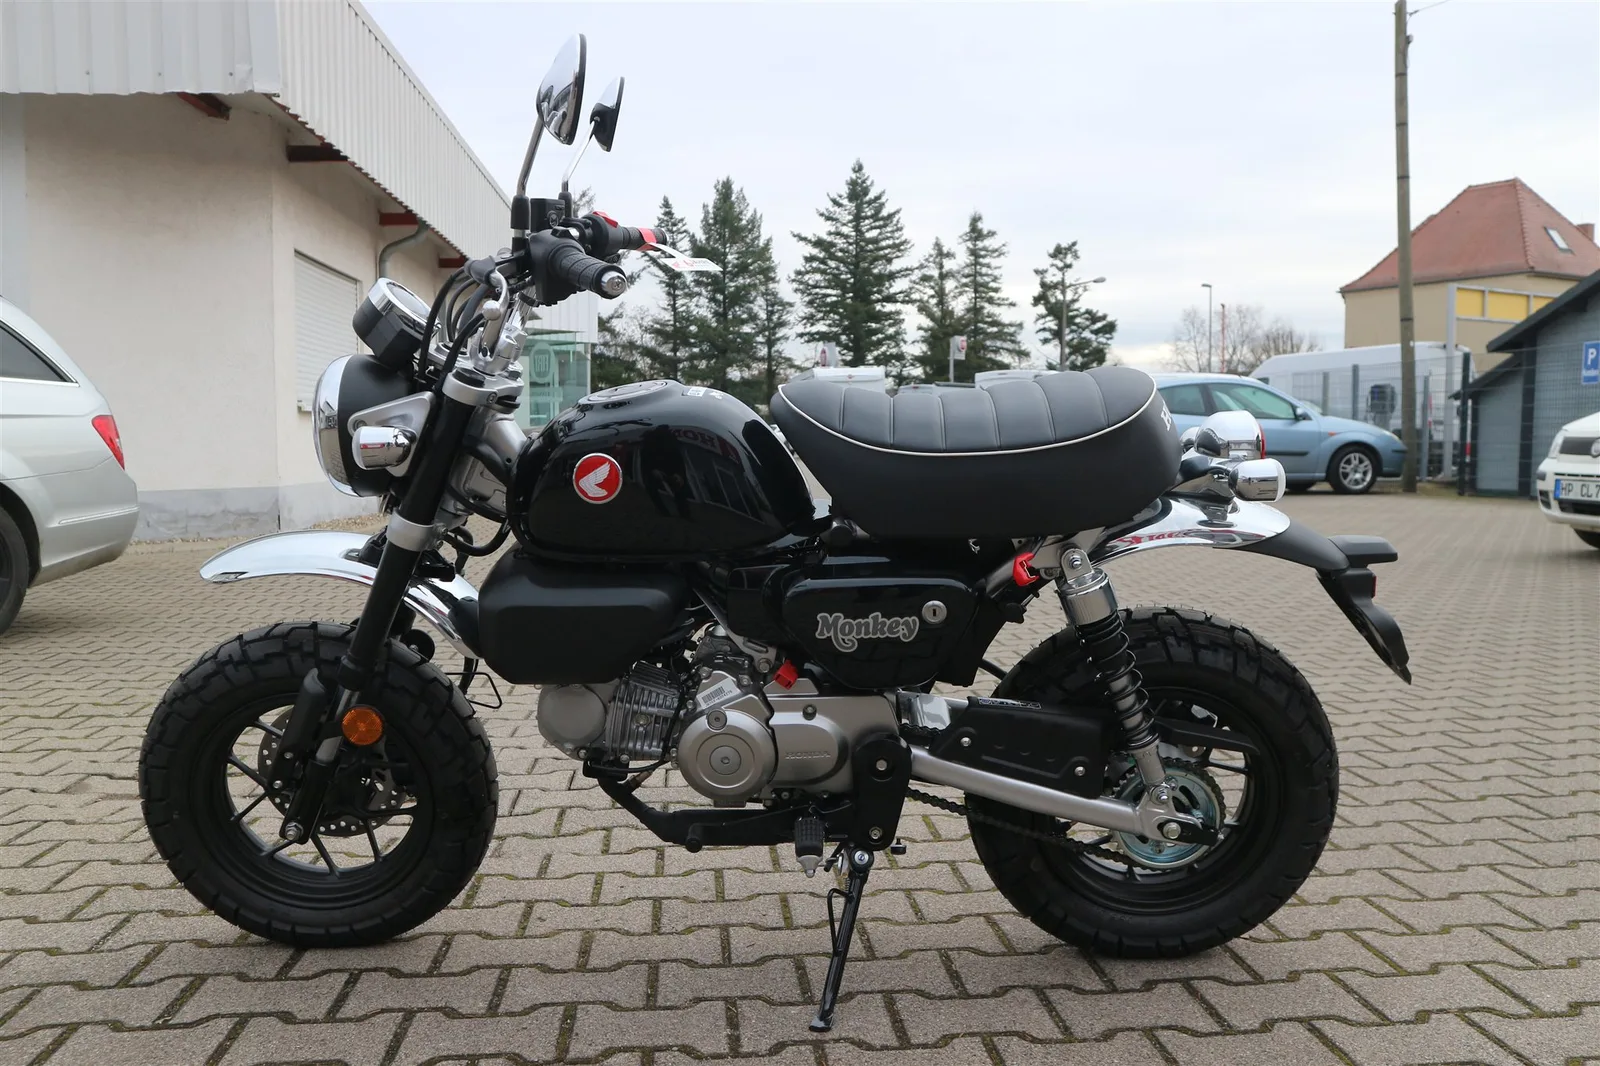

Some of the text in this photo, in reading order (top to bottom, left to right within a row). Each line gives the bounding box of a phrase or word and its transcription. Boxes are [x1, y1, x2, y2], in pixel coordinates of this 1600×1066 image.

[1587, 348, 1597, 365] P
[1561, 482, 1574, 497] HP
[1580, 483, 1593, 498] CL
[815, 612, 919, 652] Monkey
[785, 751, 831, 760] HONDA
